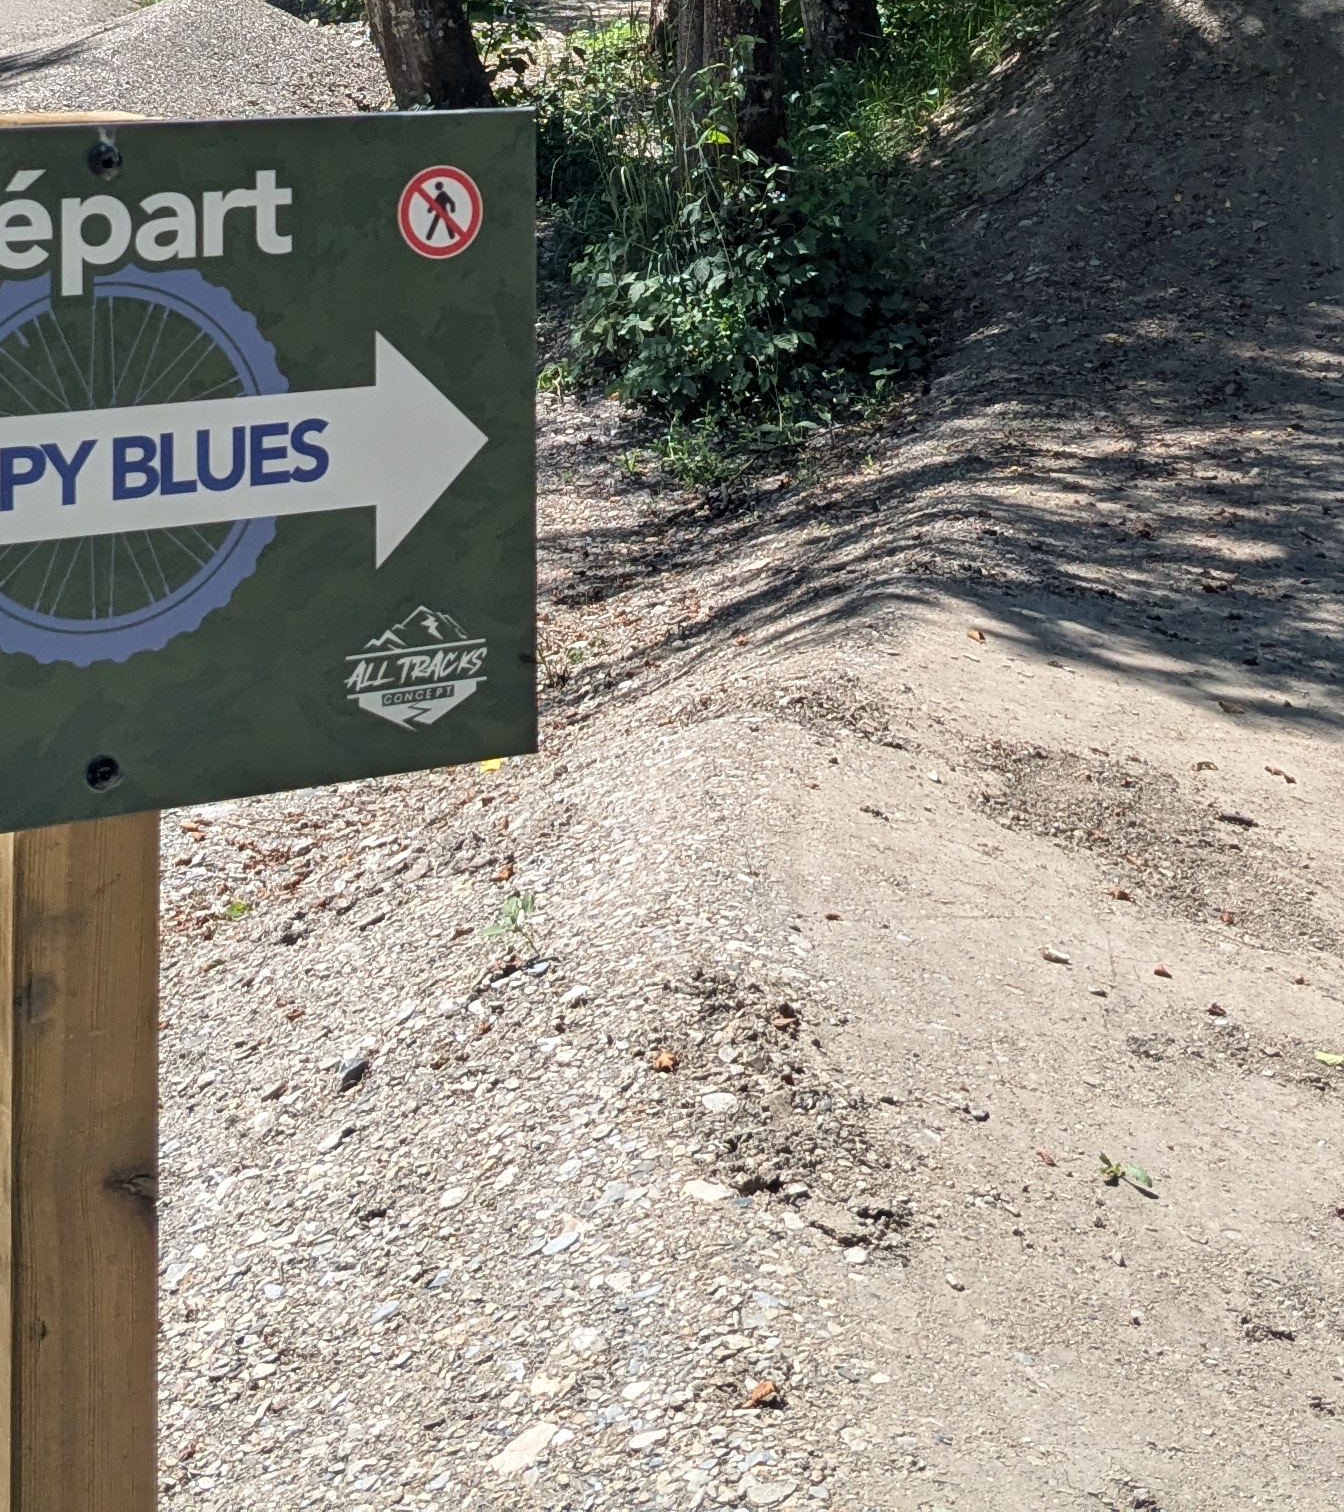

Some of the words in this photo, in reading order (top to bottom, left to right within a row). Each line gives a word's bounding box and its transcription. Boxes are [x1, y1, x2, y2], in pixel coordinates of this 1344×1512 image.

[111, 417, 330, 500] BLUES
[344, 660, 396, 691] ALL
[397, 647, 488, 685] TRACKS
[383, 686, 453, 704] CONCEPT
